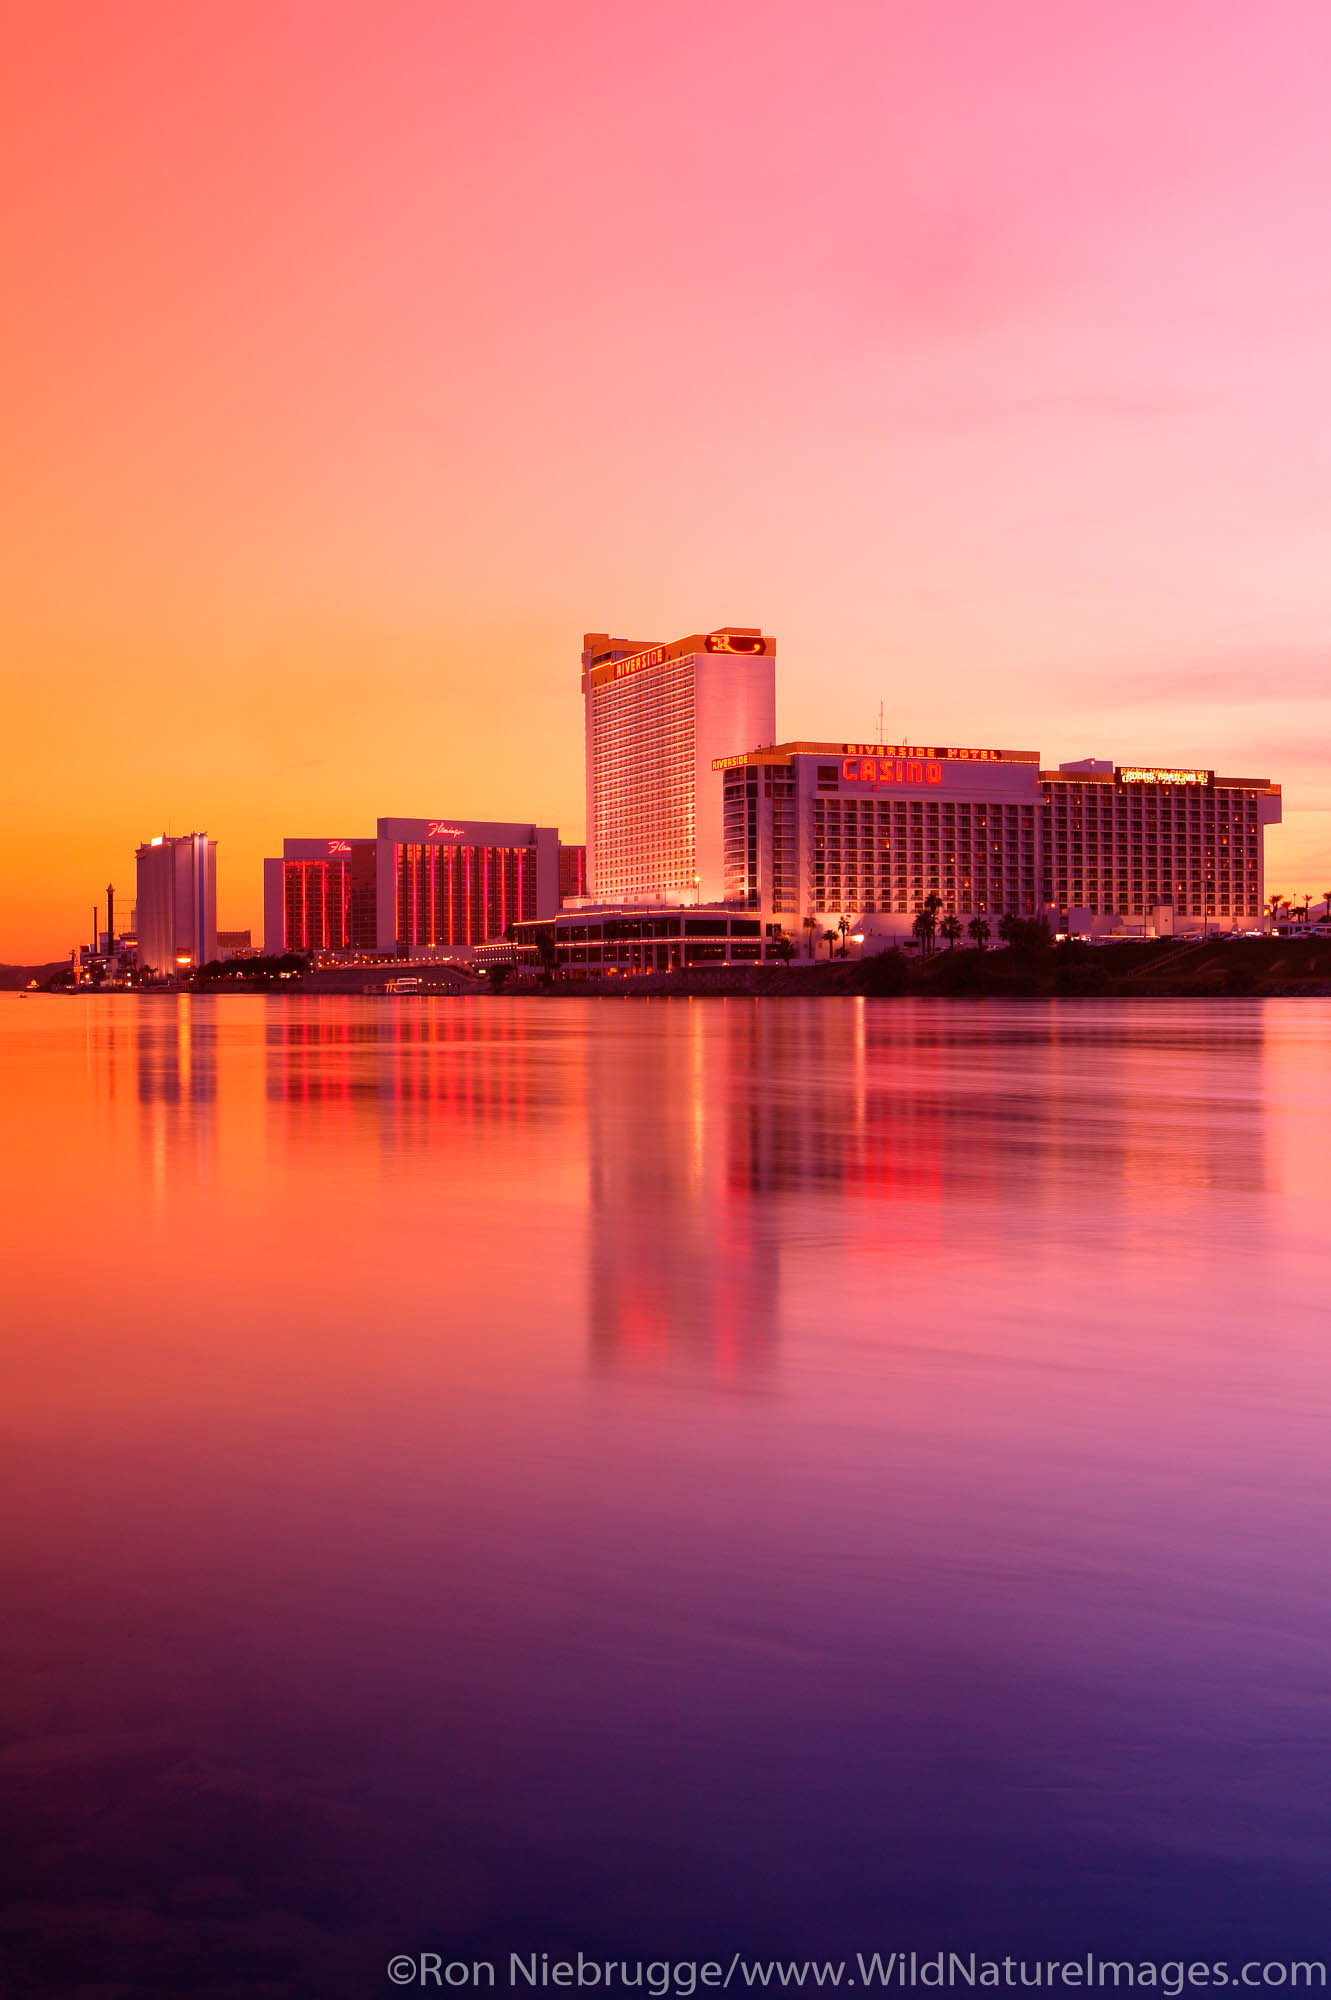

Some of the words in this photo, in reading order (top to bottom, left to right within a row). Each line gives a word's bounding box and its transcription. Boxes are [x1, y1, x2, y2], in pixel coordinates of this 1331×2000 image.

[616, 648, 662, 678] RIVERSIDE
[847, 744, 936, 757] RIVERSIDE
[947, 749, 998, 760] HOTEL
[712, 755, 748, 769] RIVERSIDE
[842, 758, 943, 784] CASINO
[428, 822, 464, 837] Flamingo
